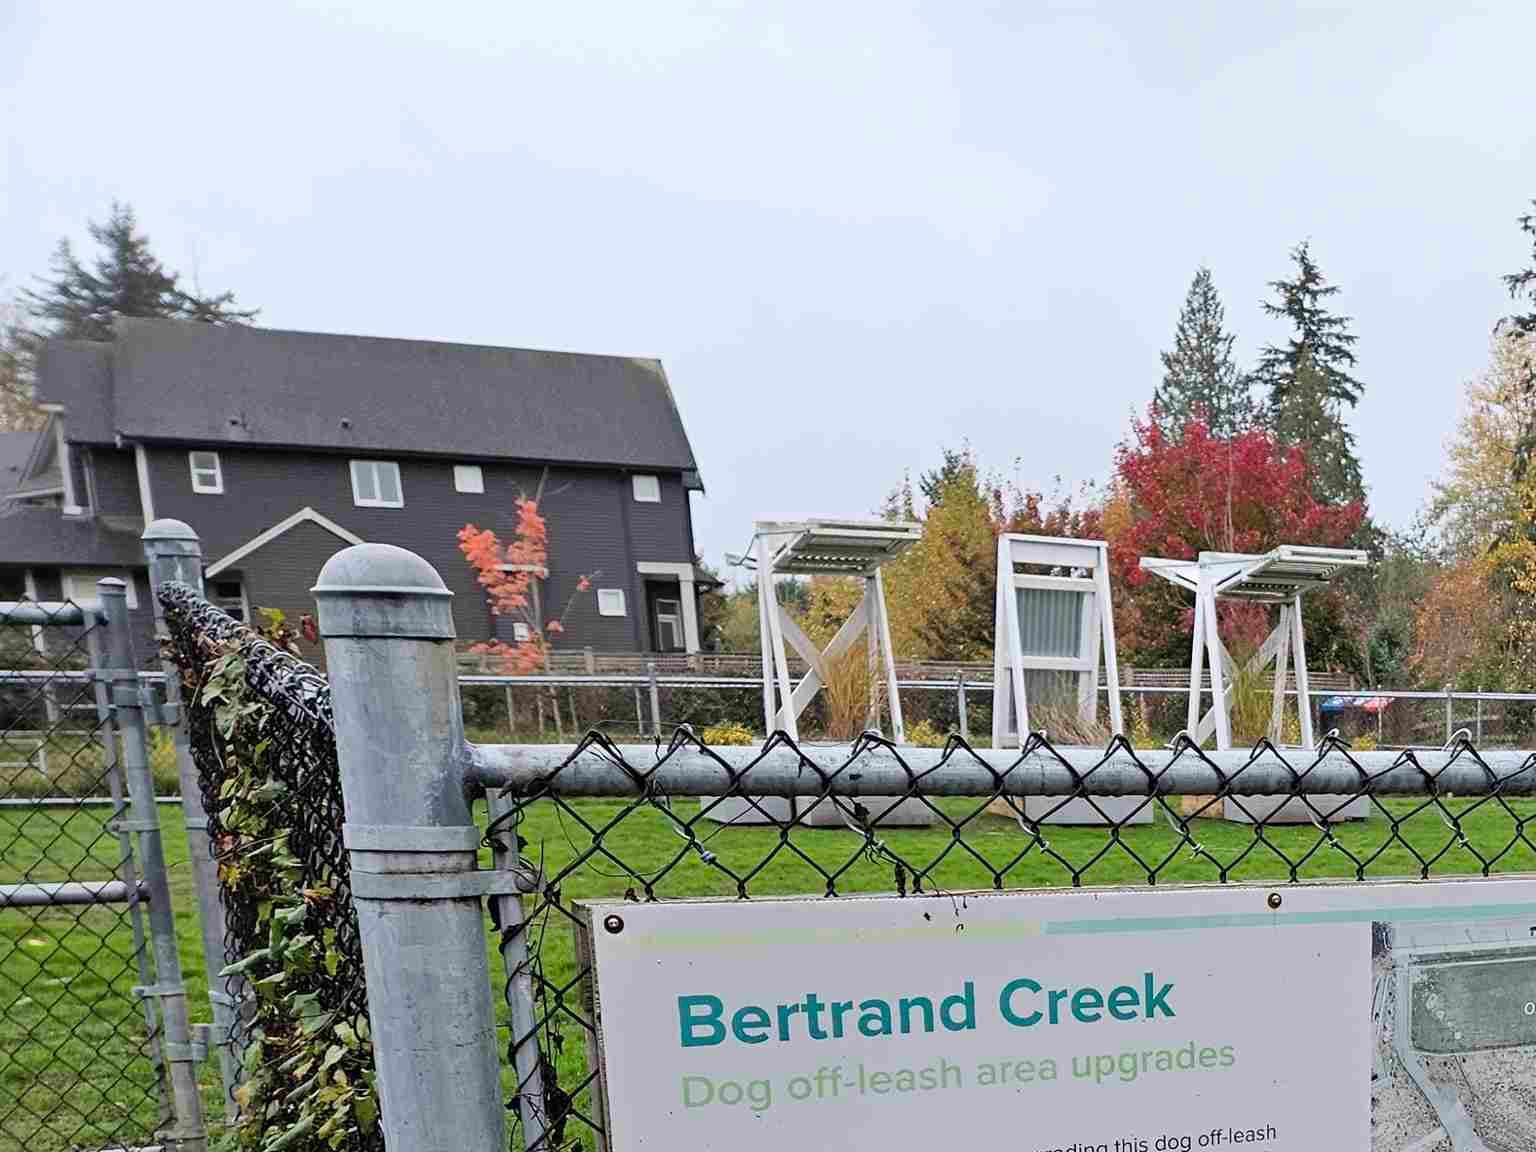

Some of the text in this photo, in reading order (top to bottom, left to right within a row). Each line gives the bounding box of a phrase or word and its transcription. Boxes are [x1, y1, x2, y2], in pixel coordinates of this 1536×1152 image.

[678, 972, 1176, 1047] Bertrand Creek
[682, 1041, 1236, 1111] Dog off-leash area upgrades
[1155, 1135, 1191, 1152] dog
[1198, 1124, 1277, 1147] off-leash
